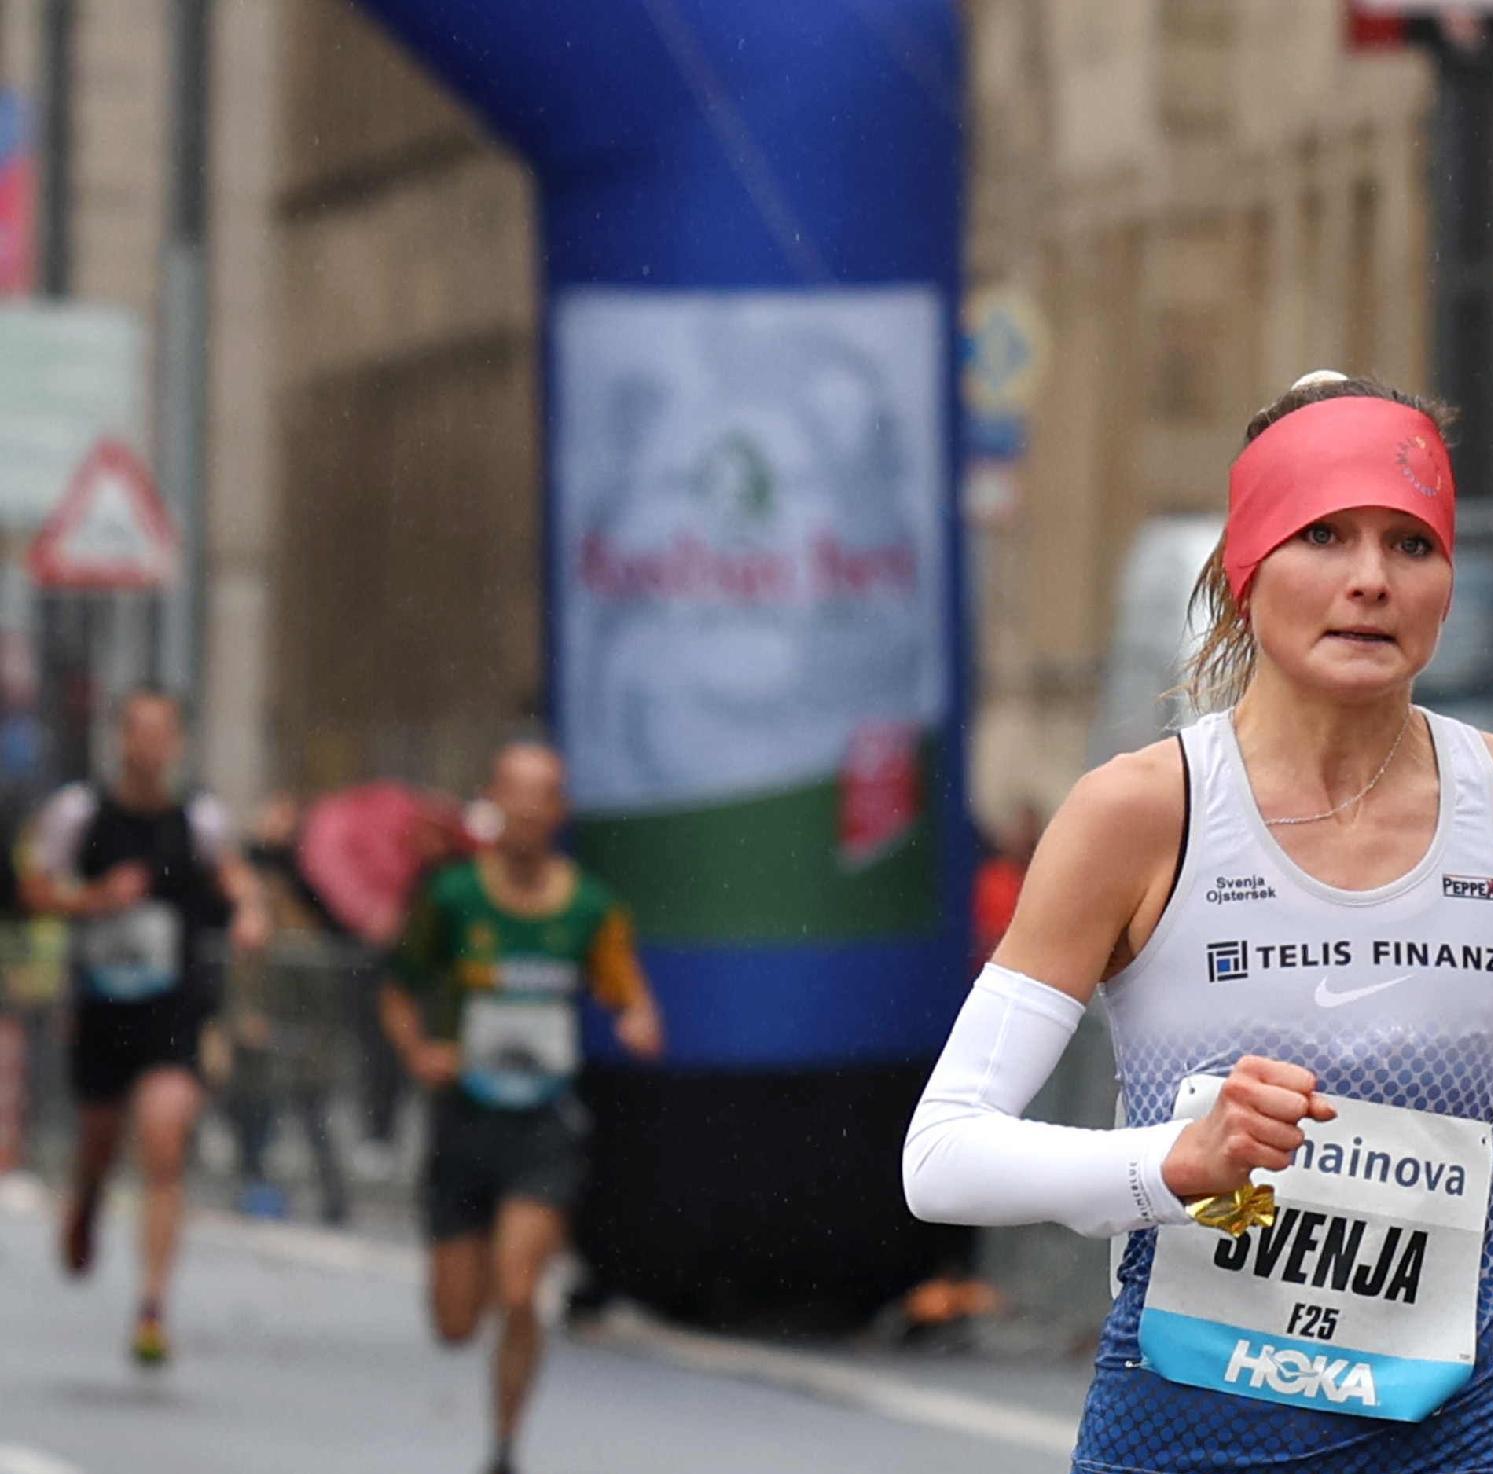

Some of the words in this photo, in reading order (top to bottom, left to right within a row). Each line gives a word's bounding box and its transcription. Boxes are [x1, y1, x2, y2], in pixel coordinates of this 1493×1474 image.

[1206, 887, 1277, 905] Ojstersek
[1216, 875, 1266, 890] Svenja
[1256, 940, 1352, 969] TELIS
[1286, 1303, 1339, 1341] F25
[1224, 1340, 1378, 1406] HOKA
